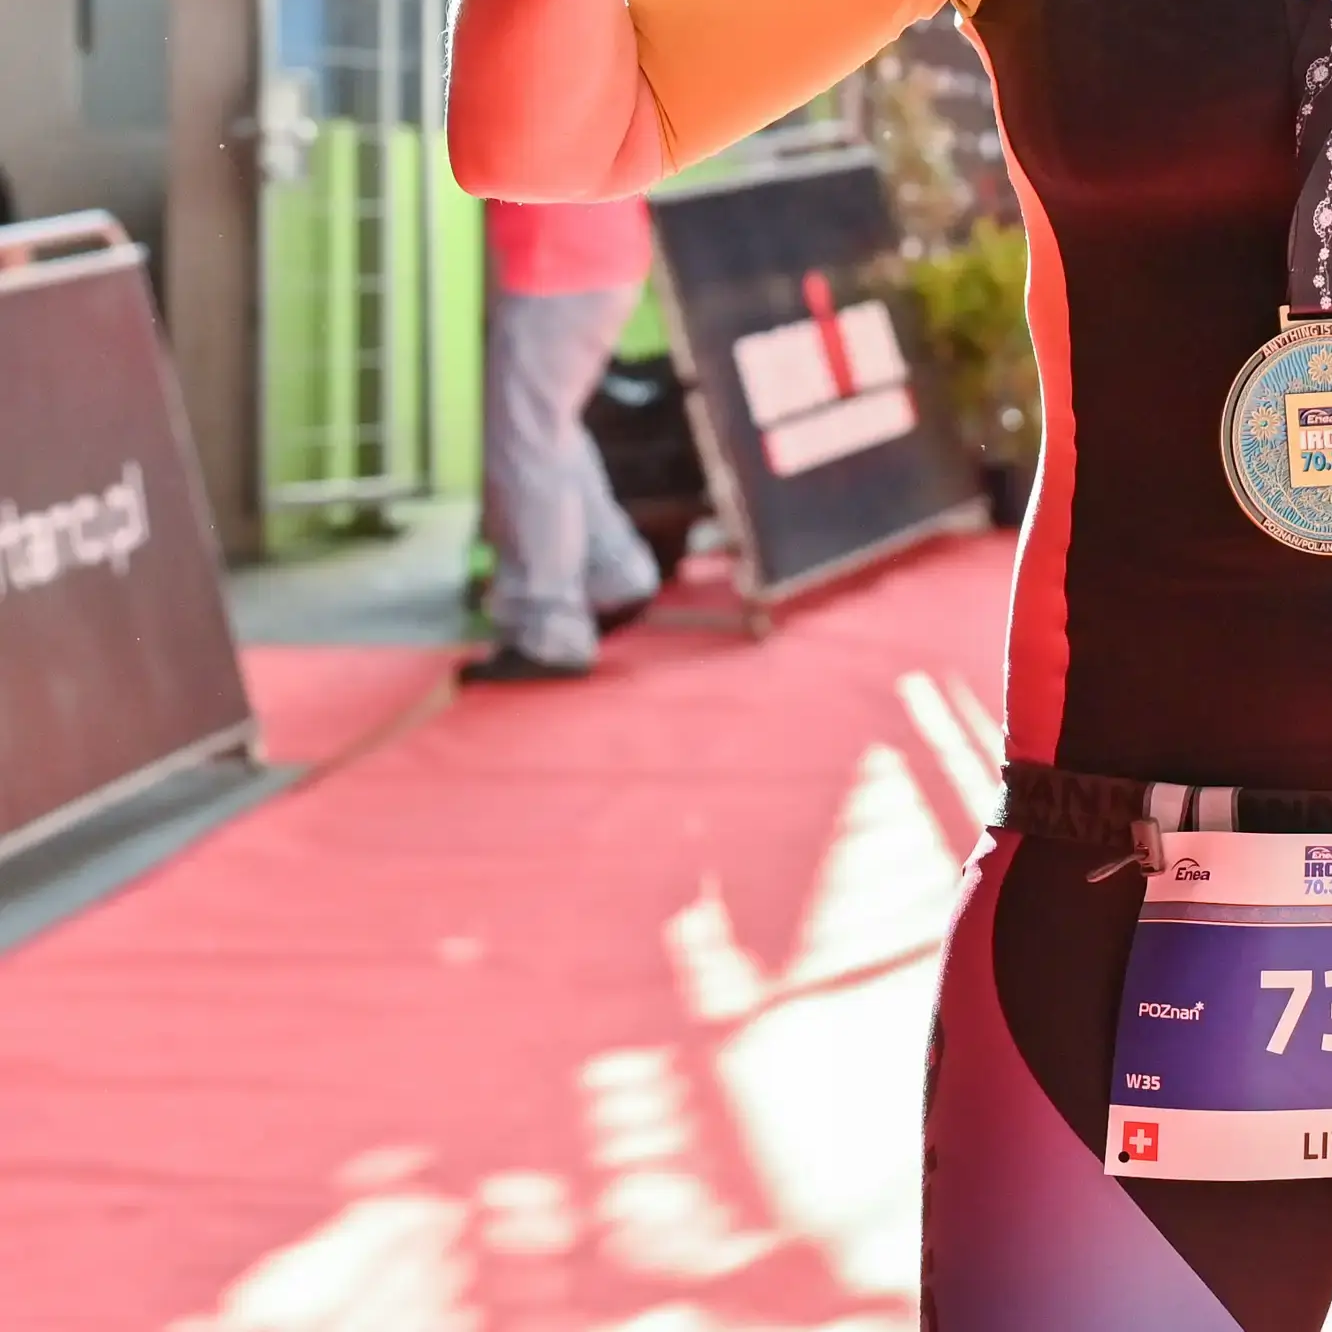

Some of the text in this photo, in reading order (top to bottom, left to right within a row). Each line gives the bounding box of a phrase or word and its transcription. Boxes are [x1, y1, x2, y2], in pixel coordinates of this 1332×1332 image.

[1262, 326, 1318, 357] ANYTHING
[1320, 324, 1331, 336] IS
[1175, 867, 1211, 881] Enea
[1126, 1073, 1161, 1091] W35
